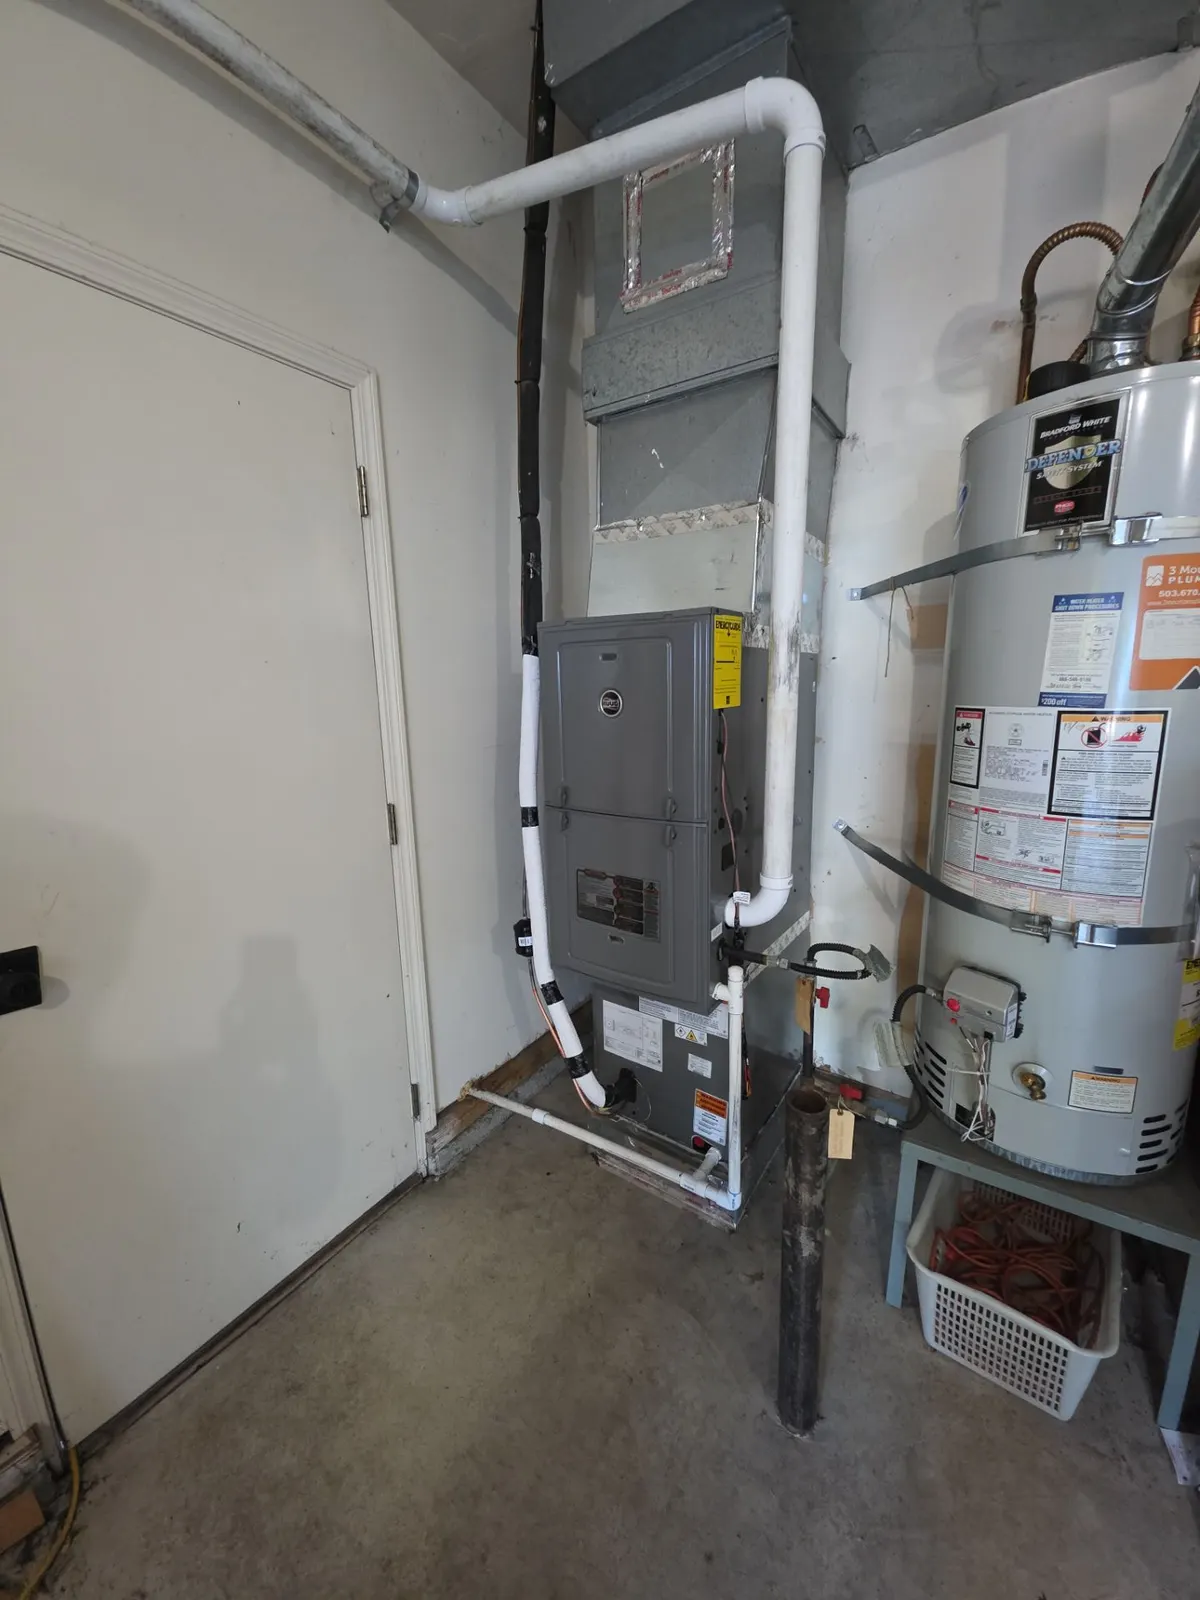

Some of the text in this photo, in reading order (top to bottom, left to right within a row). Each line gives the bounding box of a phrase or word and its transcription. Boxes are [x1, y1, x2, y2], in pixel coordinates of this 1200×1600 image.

[1040, 423, 1081, 439] BRADFORD
[1082, 416, 1112, 428] WHITE
[1025, 439, 1121, 473] DEFENDER
[1068, 460, 1103, 472] SYSTEM
[1168, 566, 1176, 575] 3
[1056, 698, 1067, 706] off
